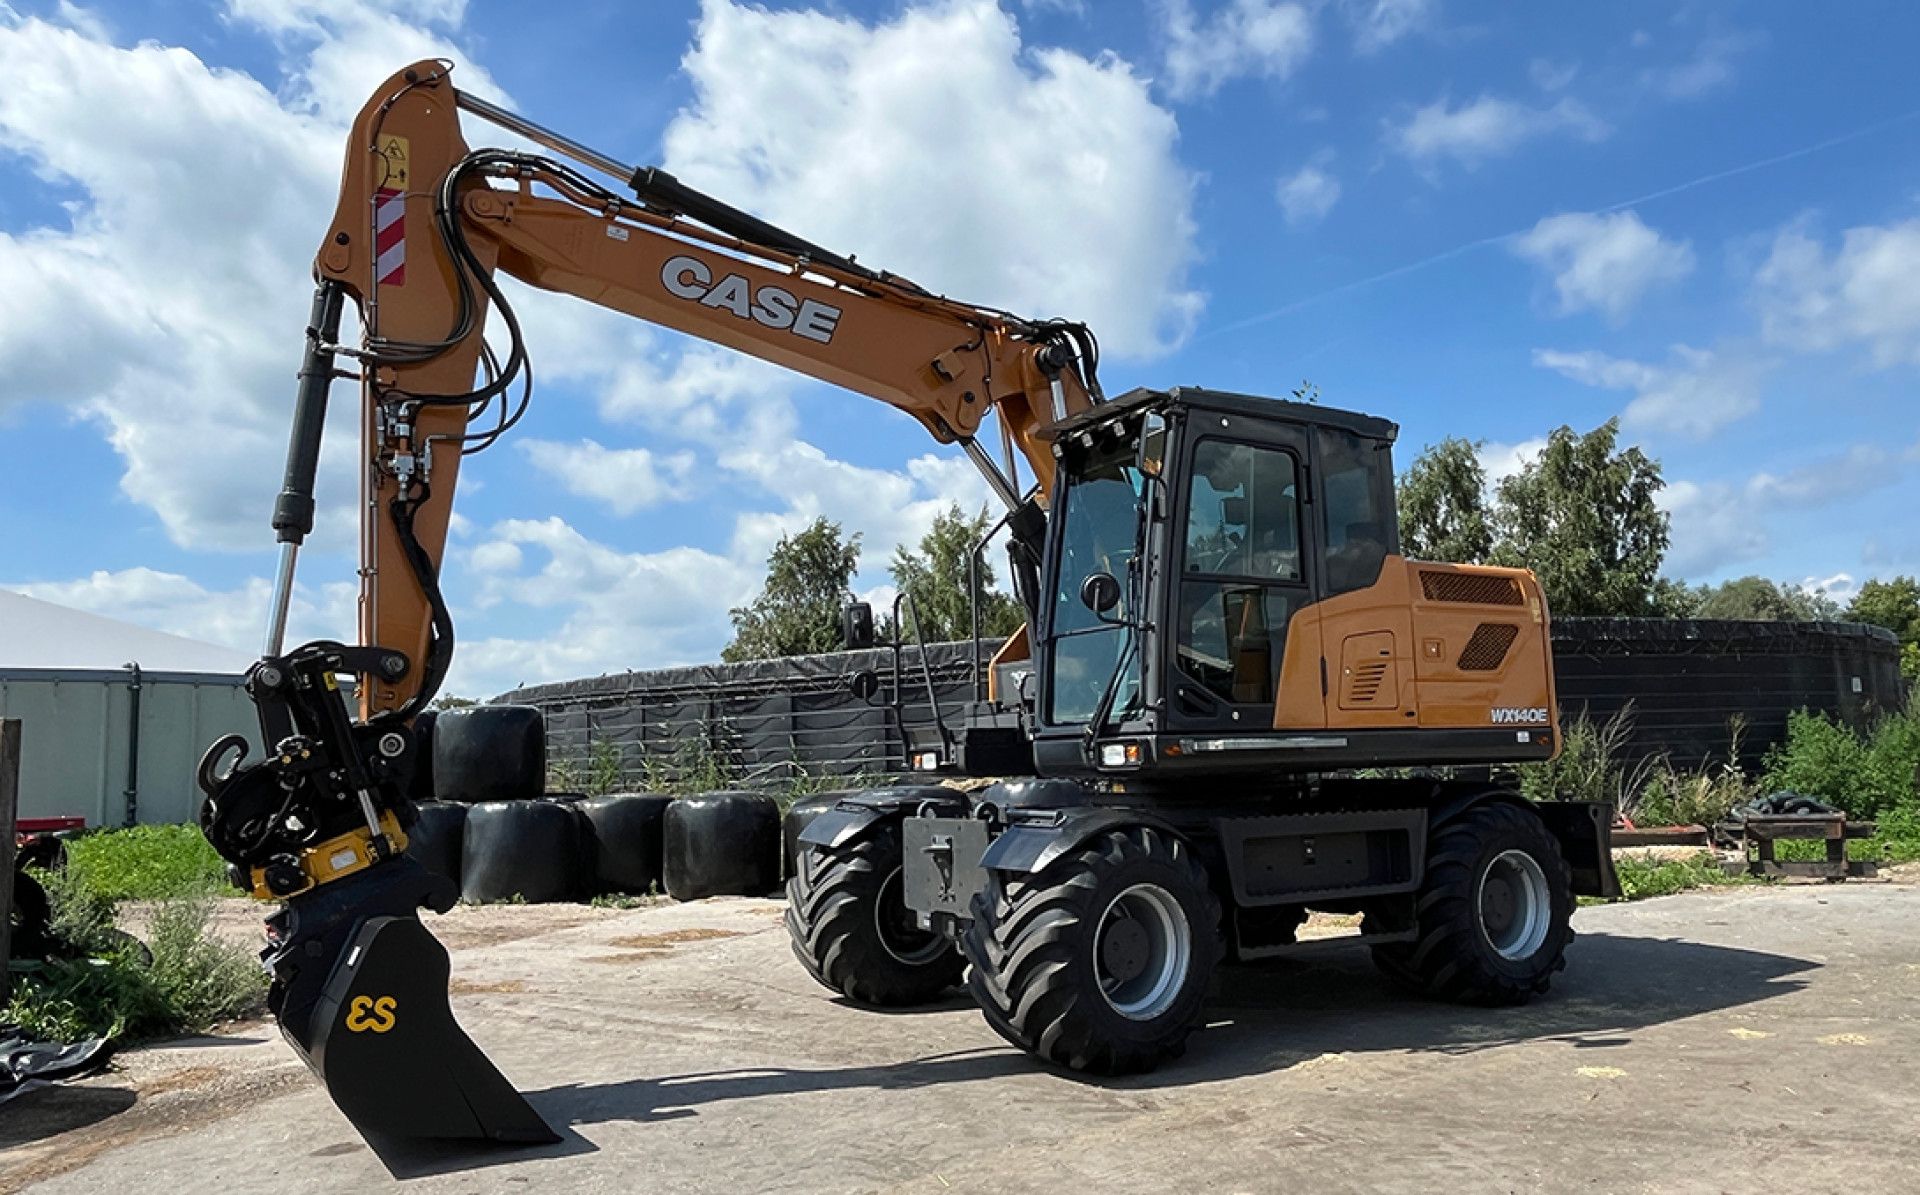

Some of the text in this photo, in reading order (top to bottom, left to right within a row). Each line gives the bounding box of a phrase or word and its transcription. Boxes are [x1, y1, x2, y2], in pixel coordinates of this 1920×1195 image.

[660, 255, 843, 344] CASE
[1491, 708, 1547, 723] WX140E
[346, 995, 397, 1032] ES
